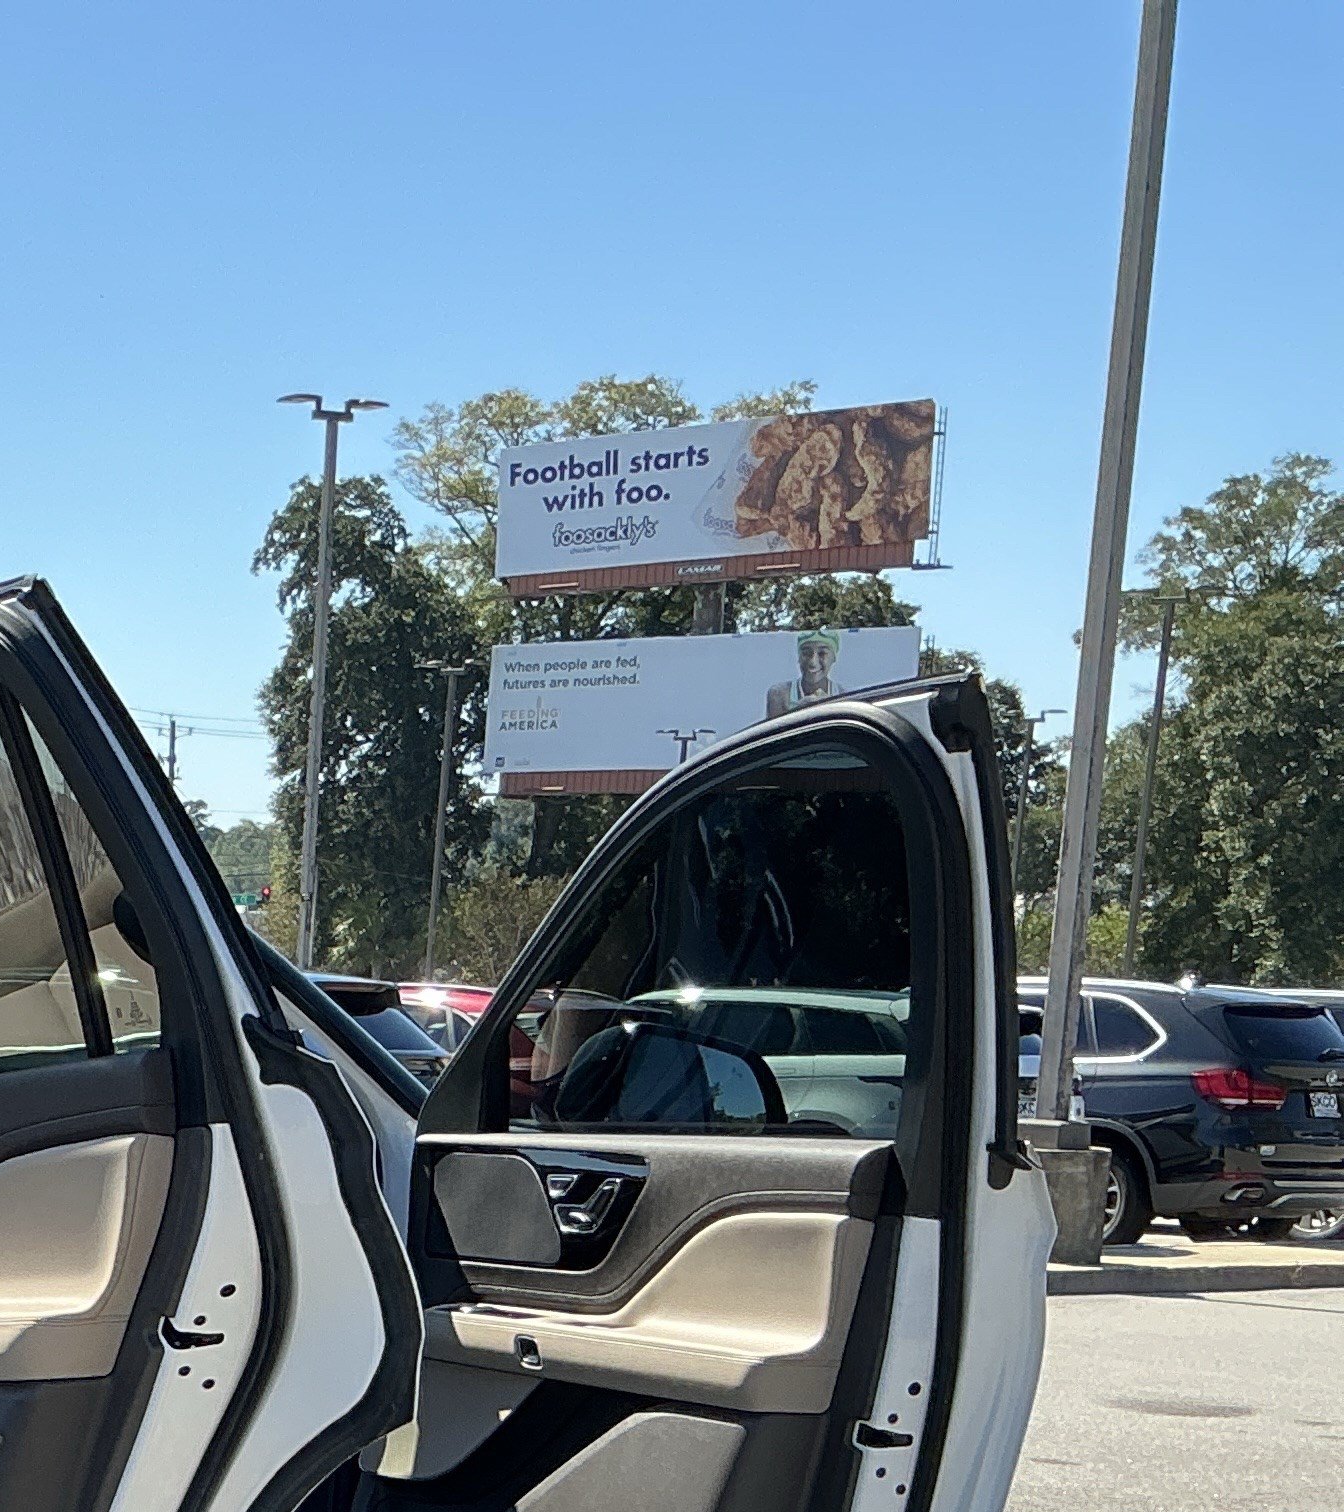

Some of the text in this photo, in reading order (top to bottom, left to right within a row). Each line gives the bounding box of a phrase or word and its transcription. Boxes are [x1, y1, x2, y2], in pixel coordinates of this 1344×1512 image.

[509, 449, 619, 488] Football
[629, 445, 710, 473] starts
[543, 478, 670, 513] with foo.
[552, 516, 659, 547] foosackly's
[504, 656, 641, 674] When people are fed,
[502, 674, 640, 690] futures are nourished.
[501, 707, 559, 720] FEEDING
[498, 719, 559, 731] AMERICA
